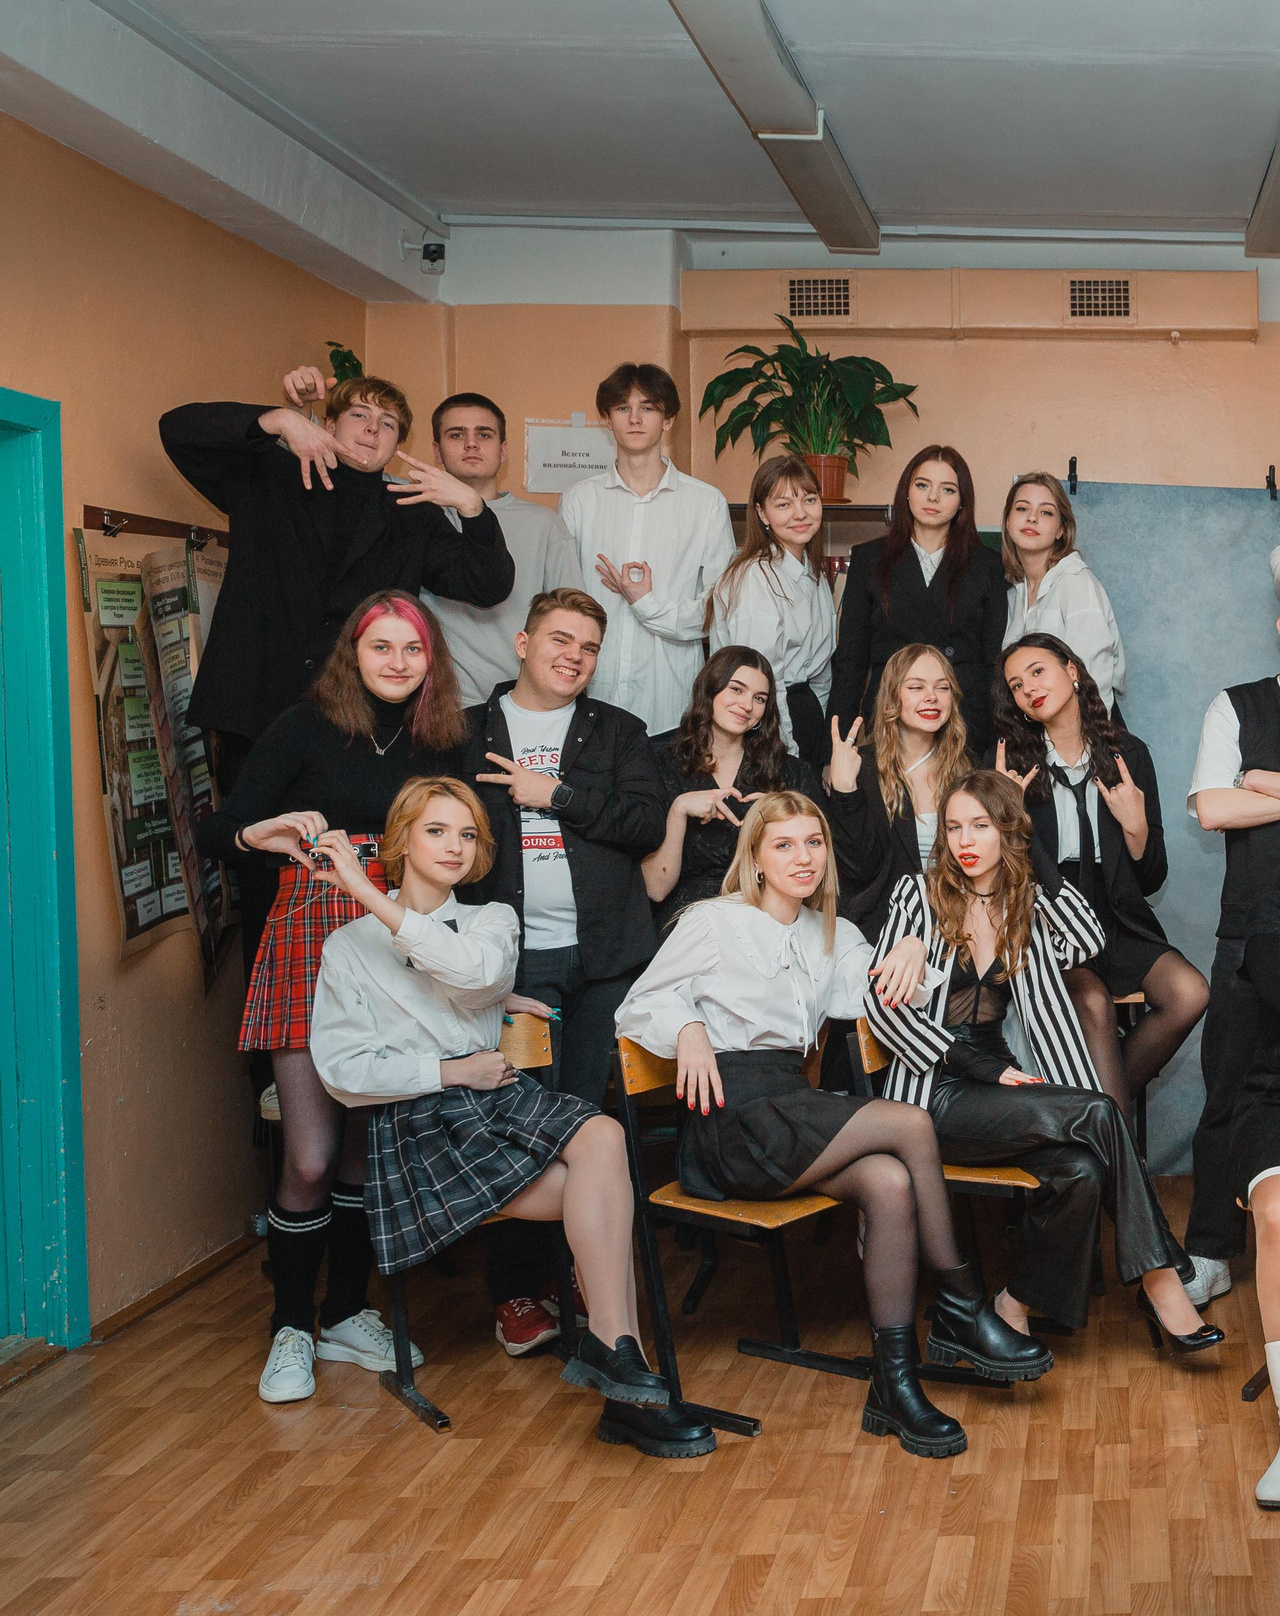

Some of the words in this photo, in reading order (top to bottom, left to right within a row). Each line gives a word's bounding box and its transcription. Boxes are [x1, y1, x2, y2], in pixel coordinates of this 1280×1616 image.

[561, 450, 590, 458] Ведется
[542, 462, 608, 470] видеонаблюдение
[95, 554, 118, 568] Древняя
[119, 556, 135, 570] Русь
[516, 754, 547, 768] EET
[522, 838, 560, 848] OUNG,
[532, 852, 551, 862] And
[552, 850, 567, 861] Fre
